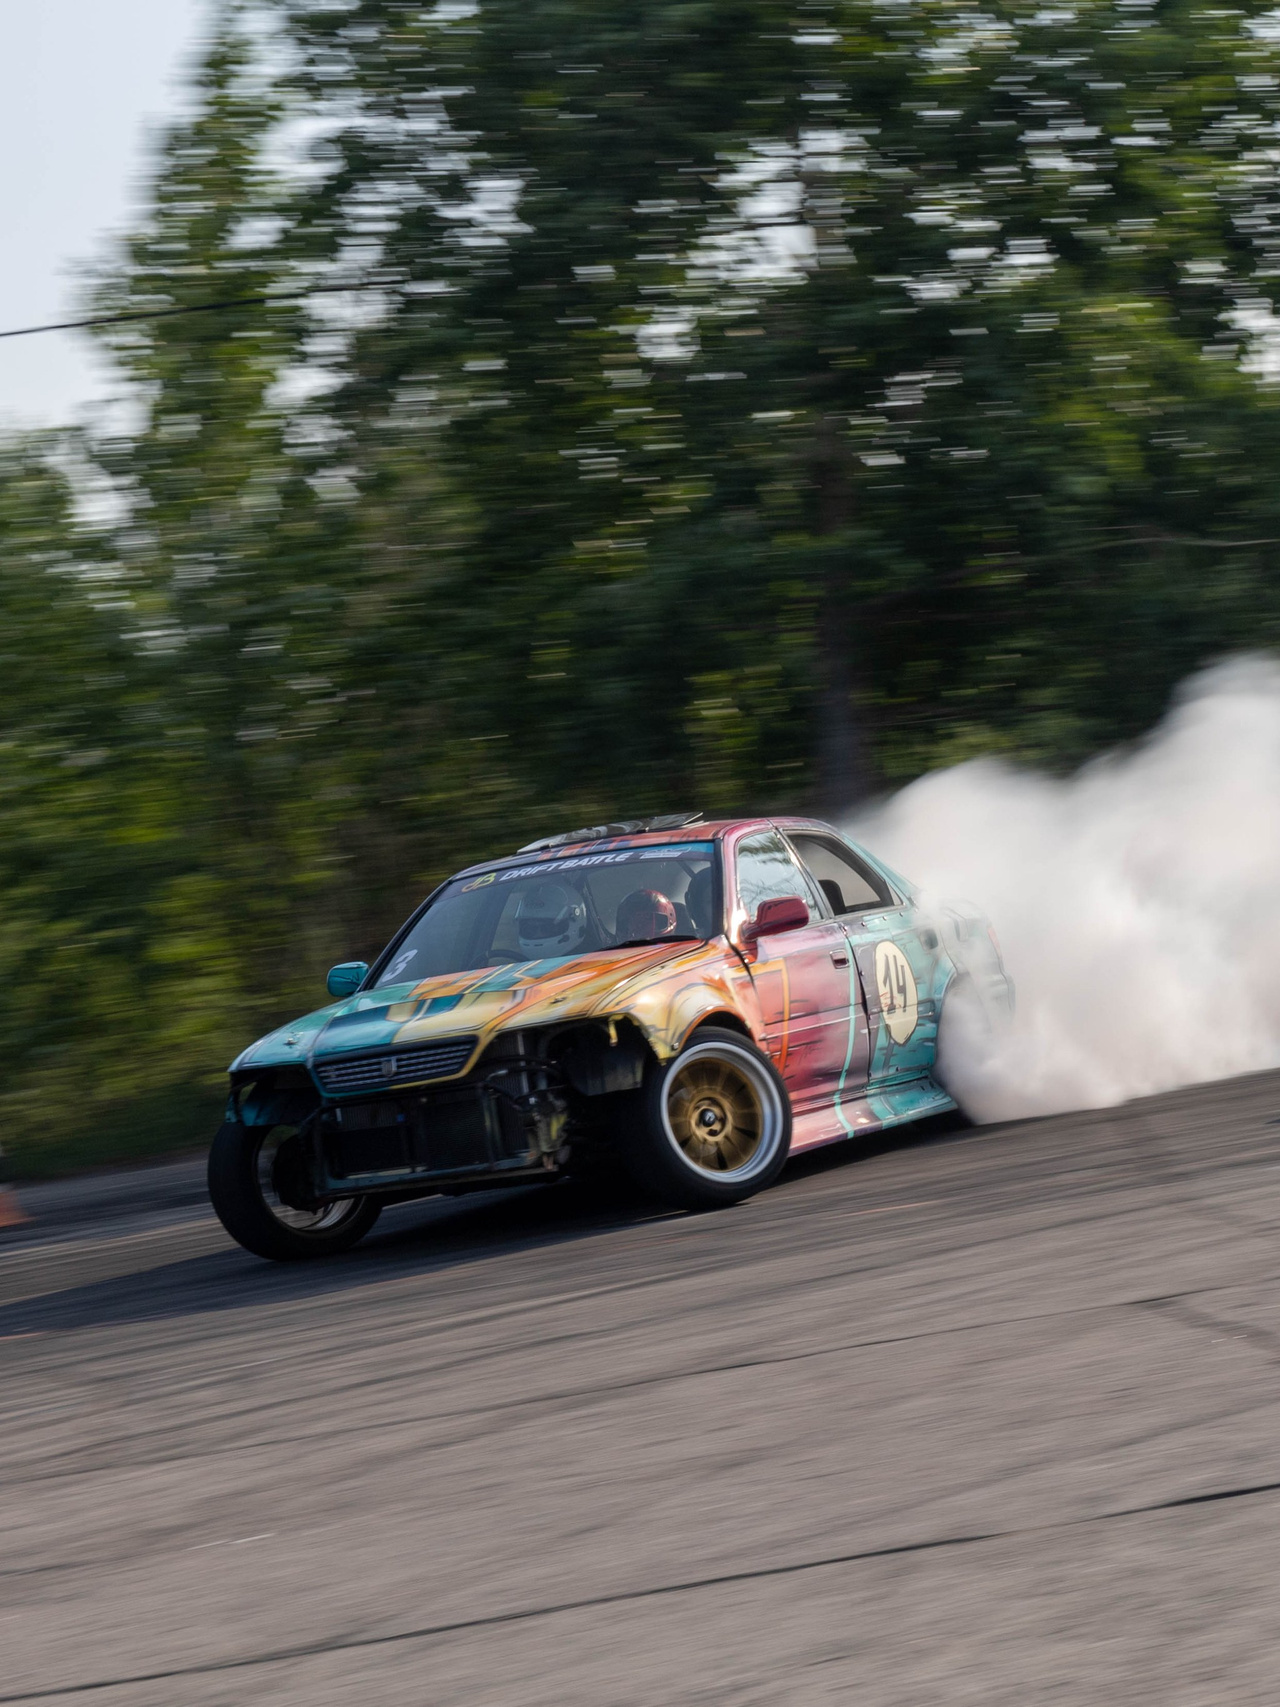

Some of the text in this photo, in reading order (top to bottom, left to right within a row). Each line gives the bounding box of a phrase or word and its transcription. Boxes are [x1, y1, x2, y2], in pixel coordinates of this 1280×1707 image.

[498, 862, 563, 882] DRIFT
[557, 852, 635, 871] BATTLE
[382, 949, 419, 983] 3
